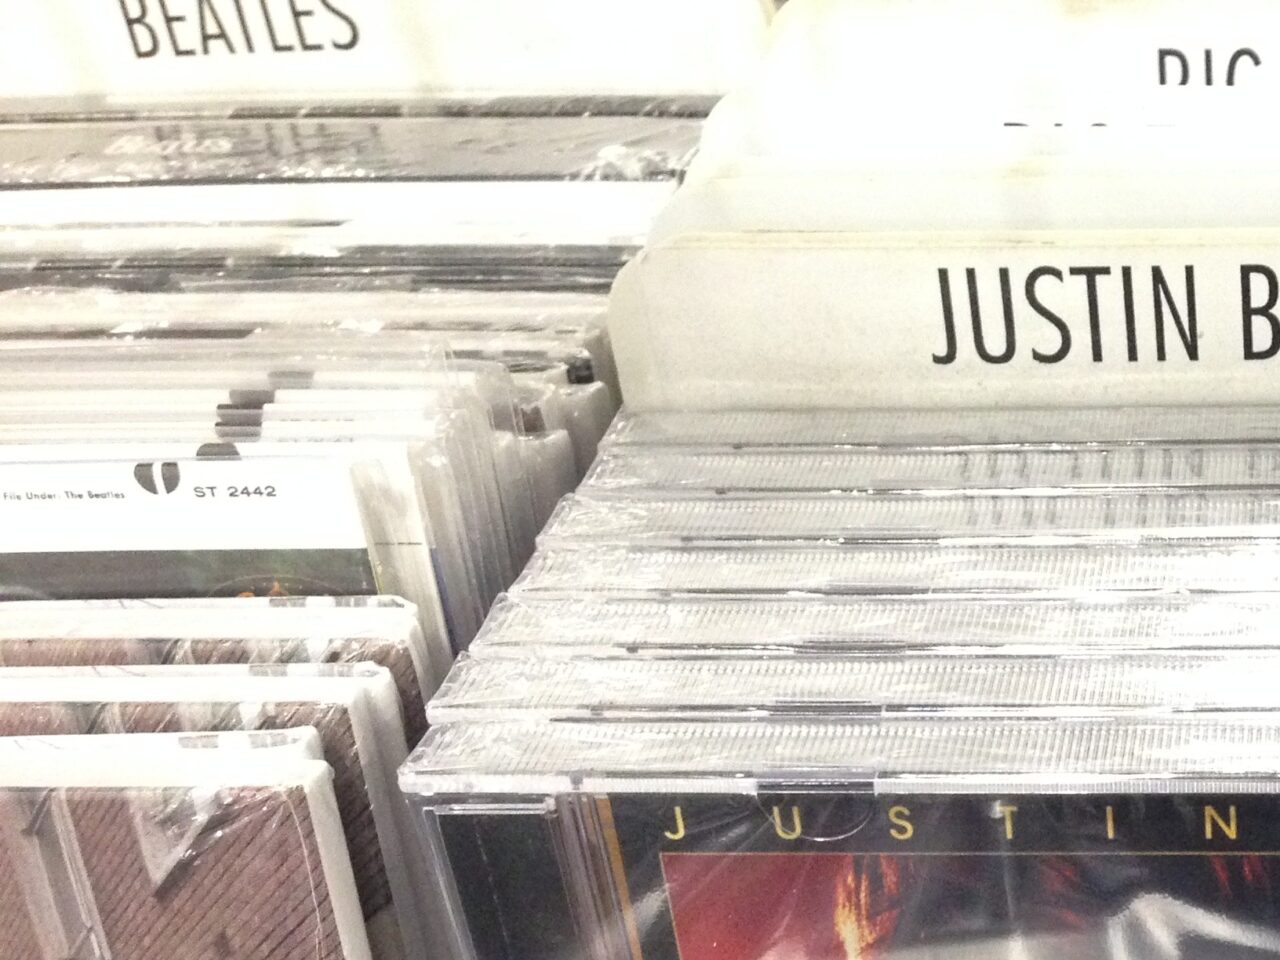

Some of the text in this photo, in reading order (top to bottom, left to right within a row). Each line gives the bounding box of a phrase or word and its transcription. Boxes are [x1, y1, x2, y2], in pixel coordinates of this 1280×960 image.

[931, 265, 1200, 365] JUSTIN
[193, 485, 277, 498] ST 2442
[663, 805, 1239, 842] JUSTIN
